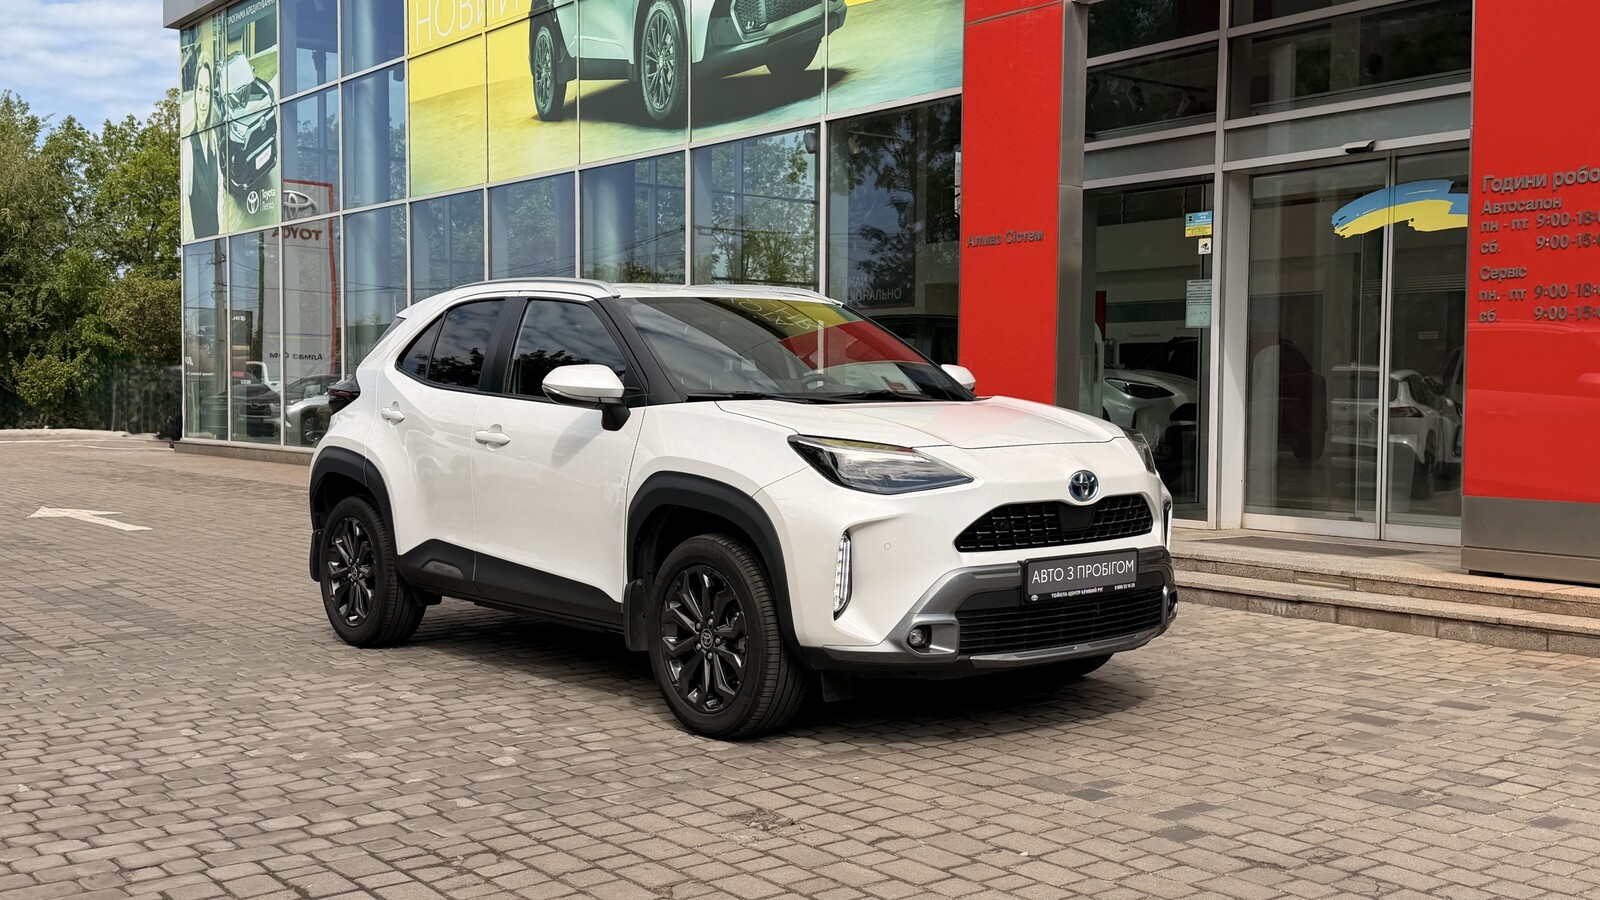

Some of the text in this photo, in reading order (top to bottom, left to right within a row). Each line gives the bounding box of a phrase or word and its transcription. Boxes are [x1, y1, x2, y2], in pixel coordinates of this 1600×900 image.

[1482, 174, 1548, 194] Години
[1481, 197, 1562, 215] Автосалон
[1536, 210, 1600, 229] 9:00-18:
[967, 229, 1044, 248] Алмаз Сістем
[1536, 232, 1600, 251] 9:00-15:
[1479, 266, 1528, 284] Сервіс
[1534, 282, 1600, 299] 9:00-18:
[1534, 305, 1600, 322] 9:00-15:
[1031, 559, 1134, 584] АВТО З ПРОБІГОМ
